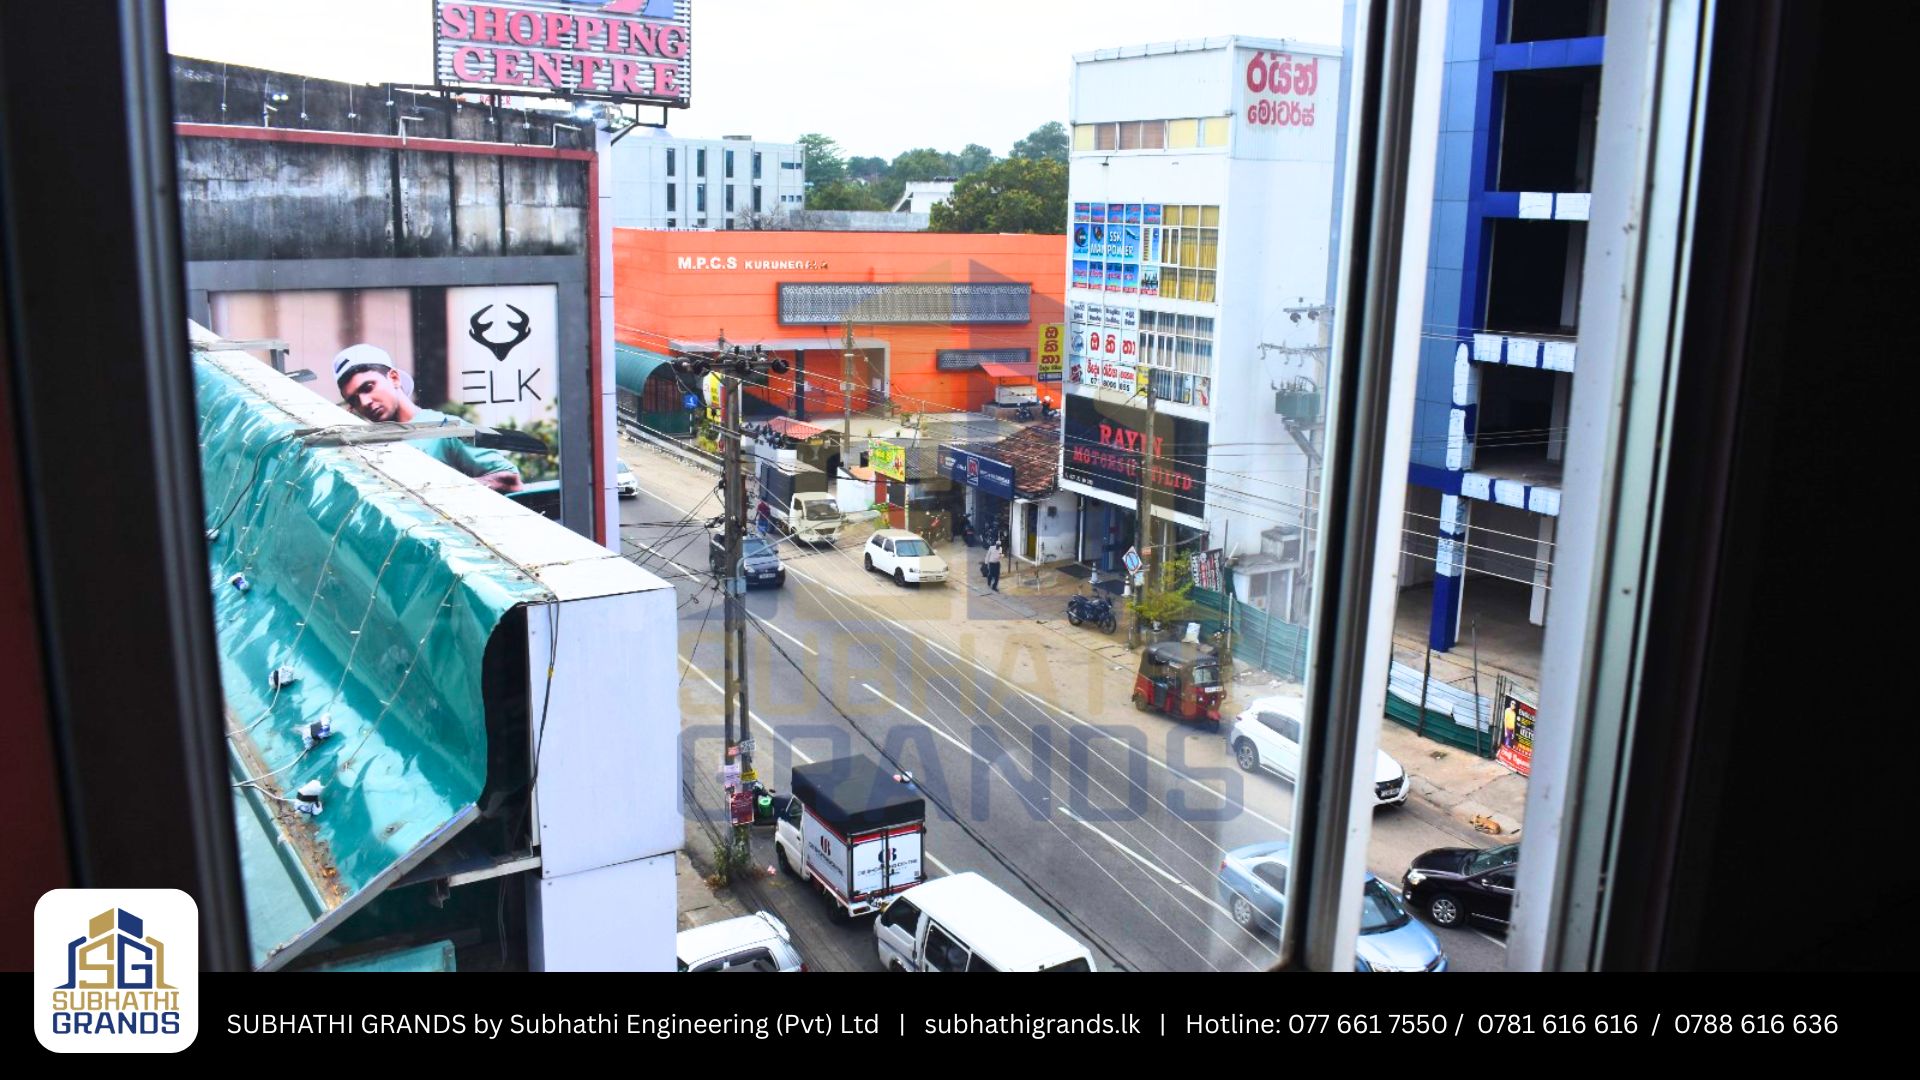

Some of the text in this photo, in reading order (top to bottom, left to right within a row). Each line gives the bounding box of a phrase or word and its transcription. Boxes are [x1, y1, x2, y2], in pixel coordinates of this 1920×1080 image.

[440, 4, 688, 59] SHOPPING
[452, 46, 681, 96] CENTRE
[1246, 51, 1318, 96] රයින්
[1247, 99, 1315, 126] මෝටර්ස්
[677, 256, 738, 270] M.P.C.S
[461, 368, 542, 405] ELK
[1098, 424, 1164, 459] RAYIN
